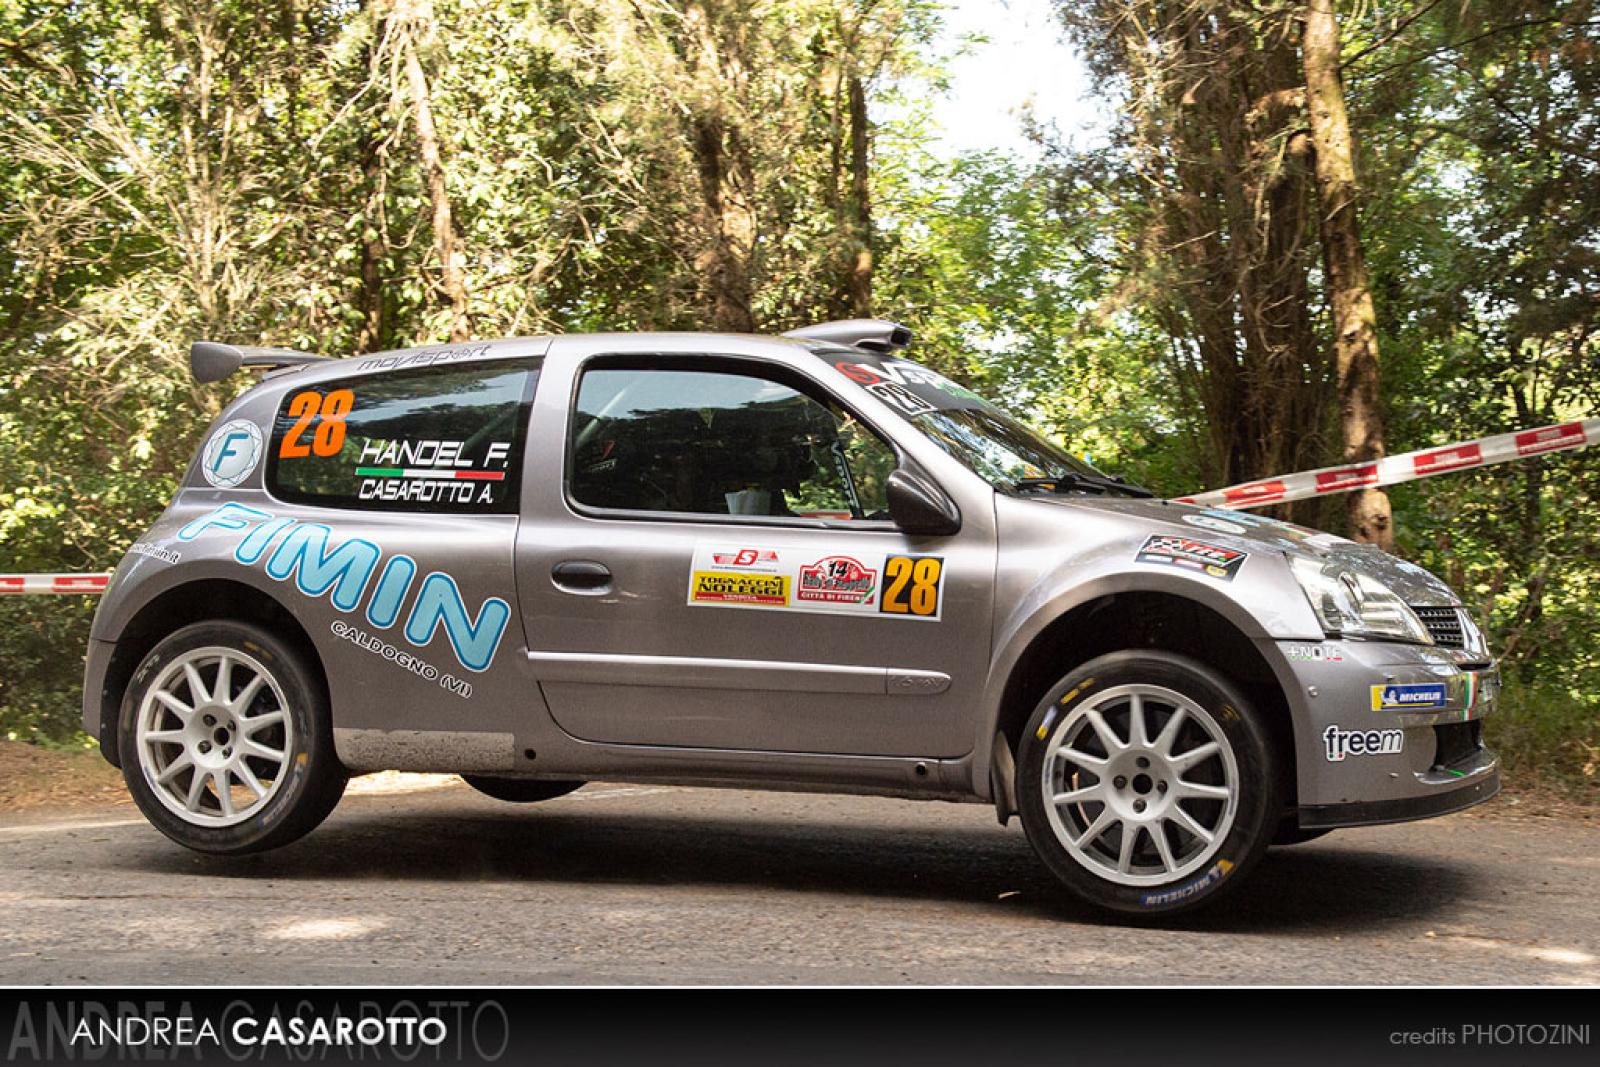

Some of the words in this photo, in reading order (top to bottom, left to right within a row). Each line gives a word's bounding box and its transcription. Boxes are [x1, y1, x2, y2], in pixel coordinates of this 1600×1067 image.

[279, 389, 355, 459] 28
[213, 433, 250, 473] F
[357, 438, 474, 468] HANDEL
[482, 441, 512, 468] F.
[358, 478, 476, 504] CASAROTTO
[476, 482, 495, 504] A.
[177, 501, 512, 673] FIMIN
[881, 556, 941, 616] 28
[330, 620, 439, 681] CALDOGNO
[439, 673, 473, 699] (VI)
[1324, 725, 1403, 761] freem
